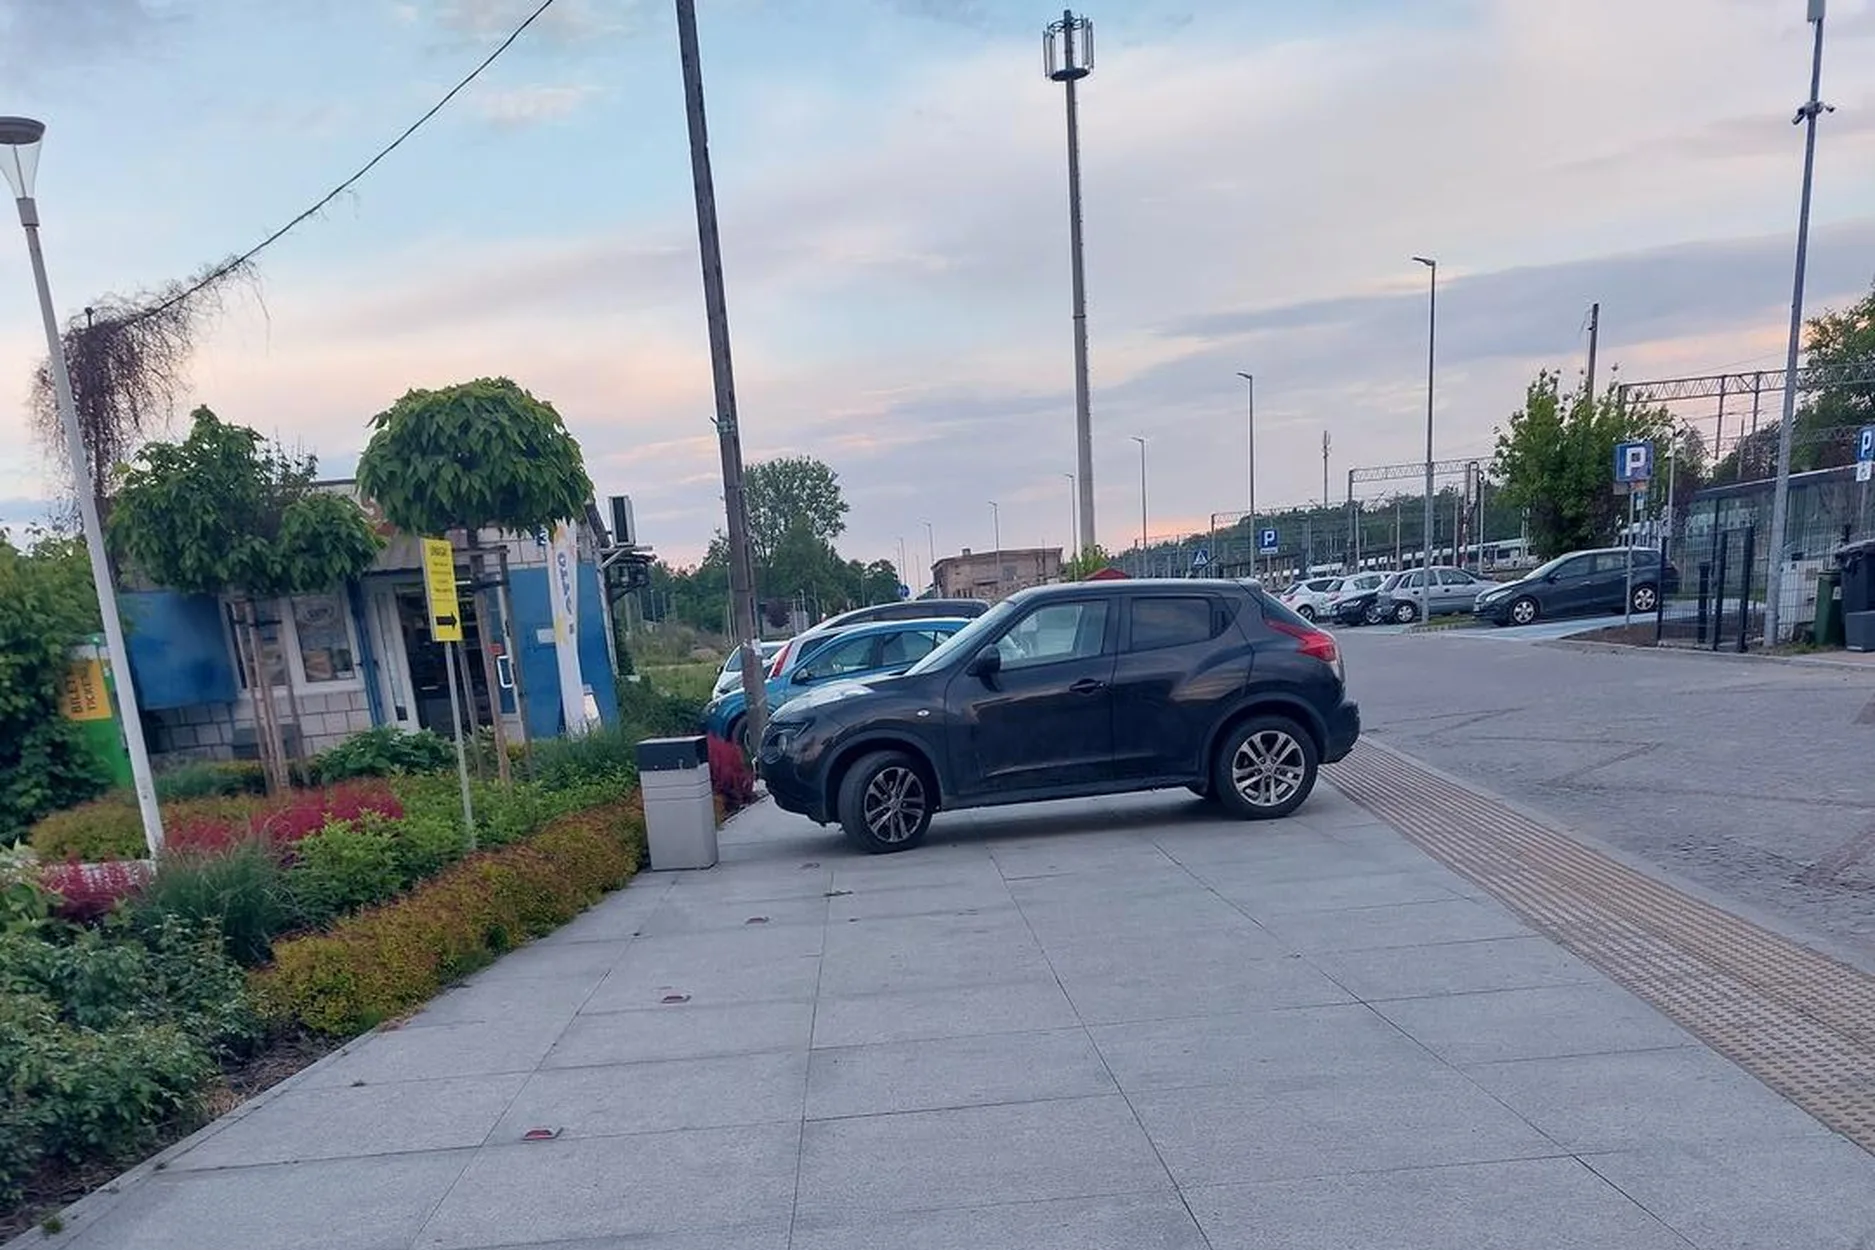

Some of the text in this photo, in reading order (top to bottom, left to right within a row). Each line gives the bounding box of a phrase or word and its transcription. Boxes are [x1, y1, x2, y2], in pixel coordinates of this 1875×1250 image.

[1861, 430, 1873, 458] P
[1625, 446, 1647, 477] P
[1264, 530, 1276, 546] P
